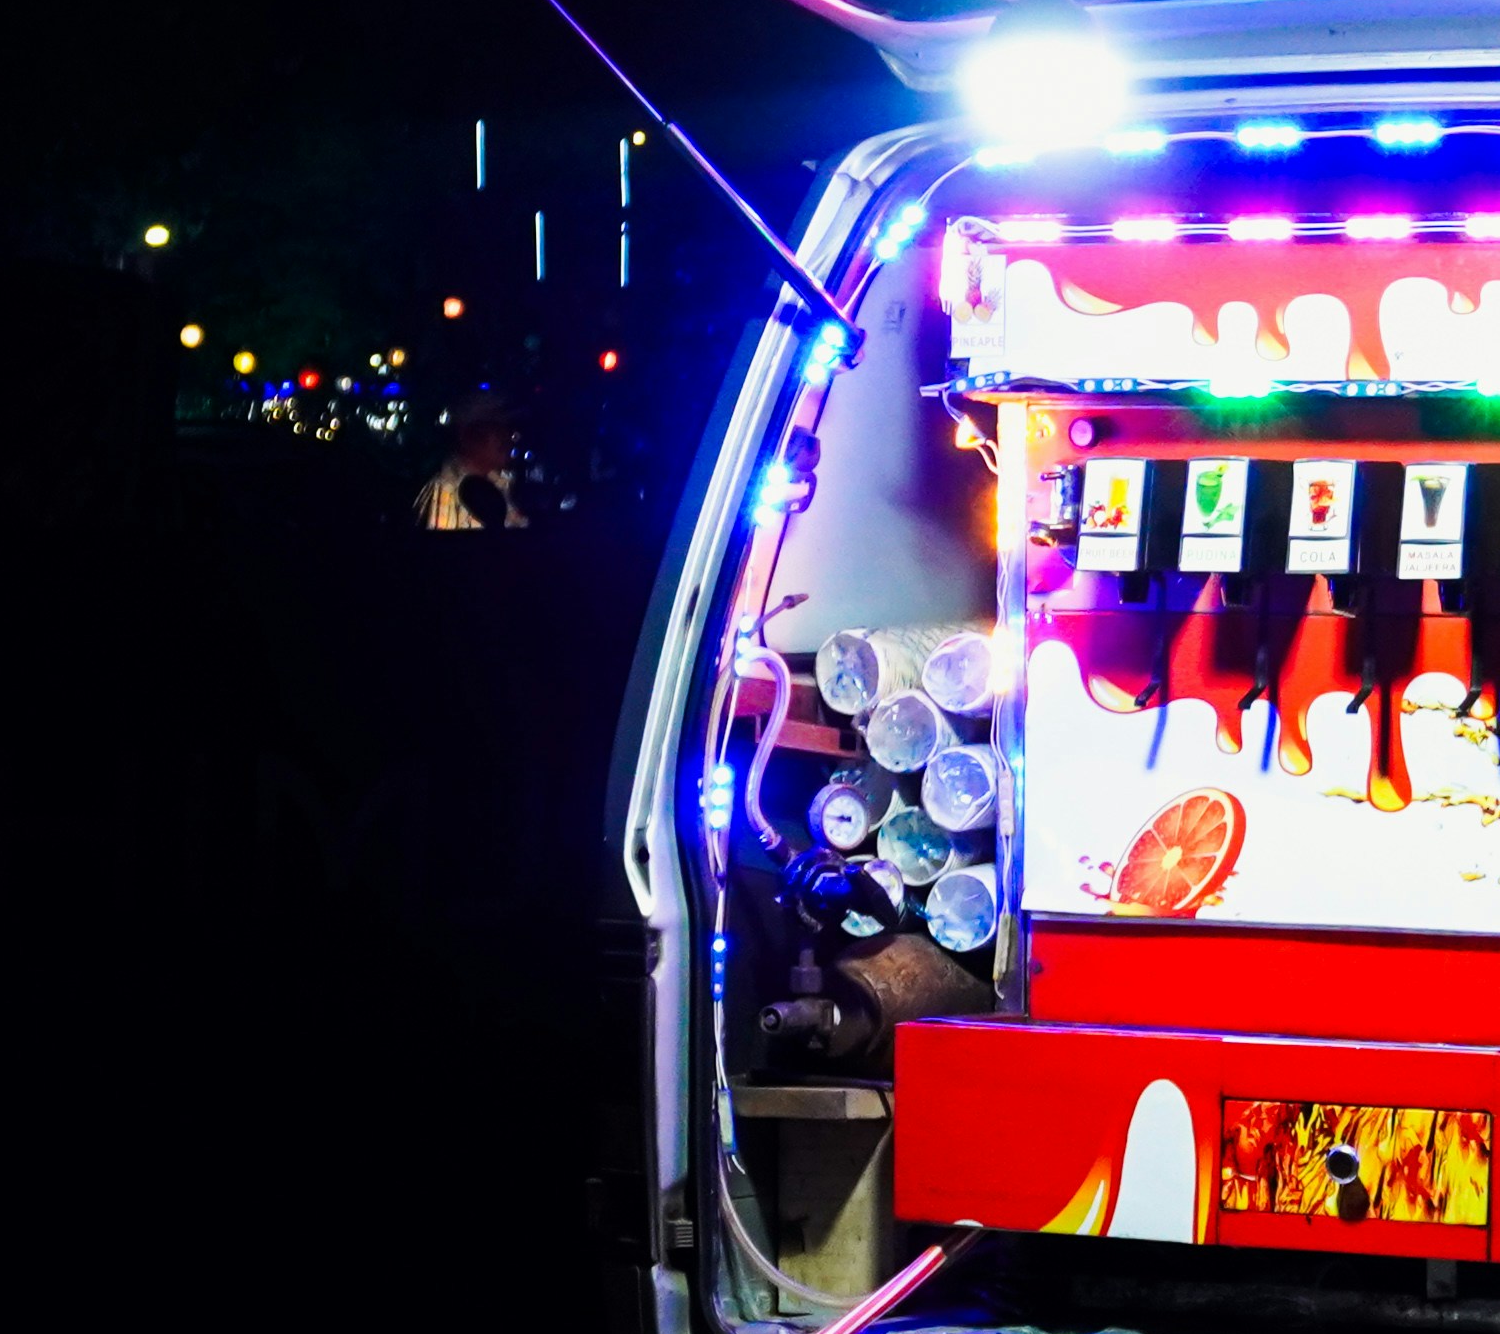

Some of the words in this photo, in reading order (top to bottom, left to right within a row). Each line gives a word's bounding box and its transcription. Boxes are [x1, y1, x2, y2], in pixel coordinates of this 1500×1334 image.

[1186, 549, 1237, 562] PUDINA
[1299, 551, 1336, 563] COLA
[1408, 551, 1454, 560] MASALA
